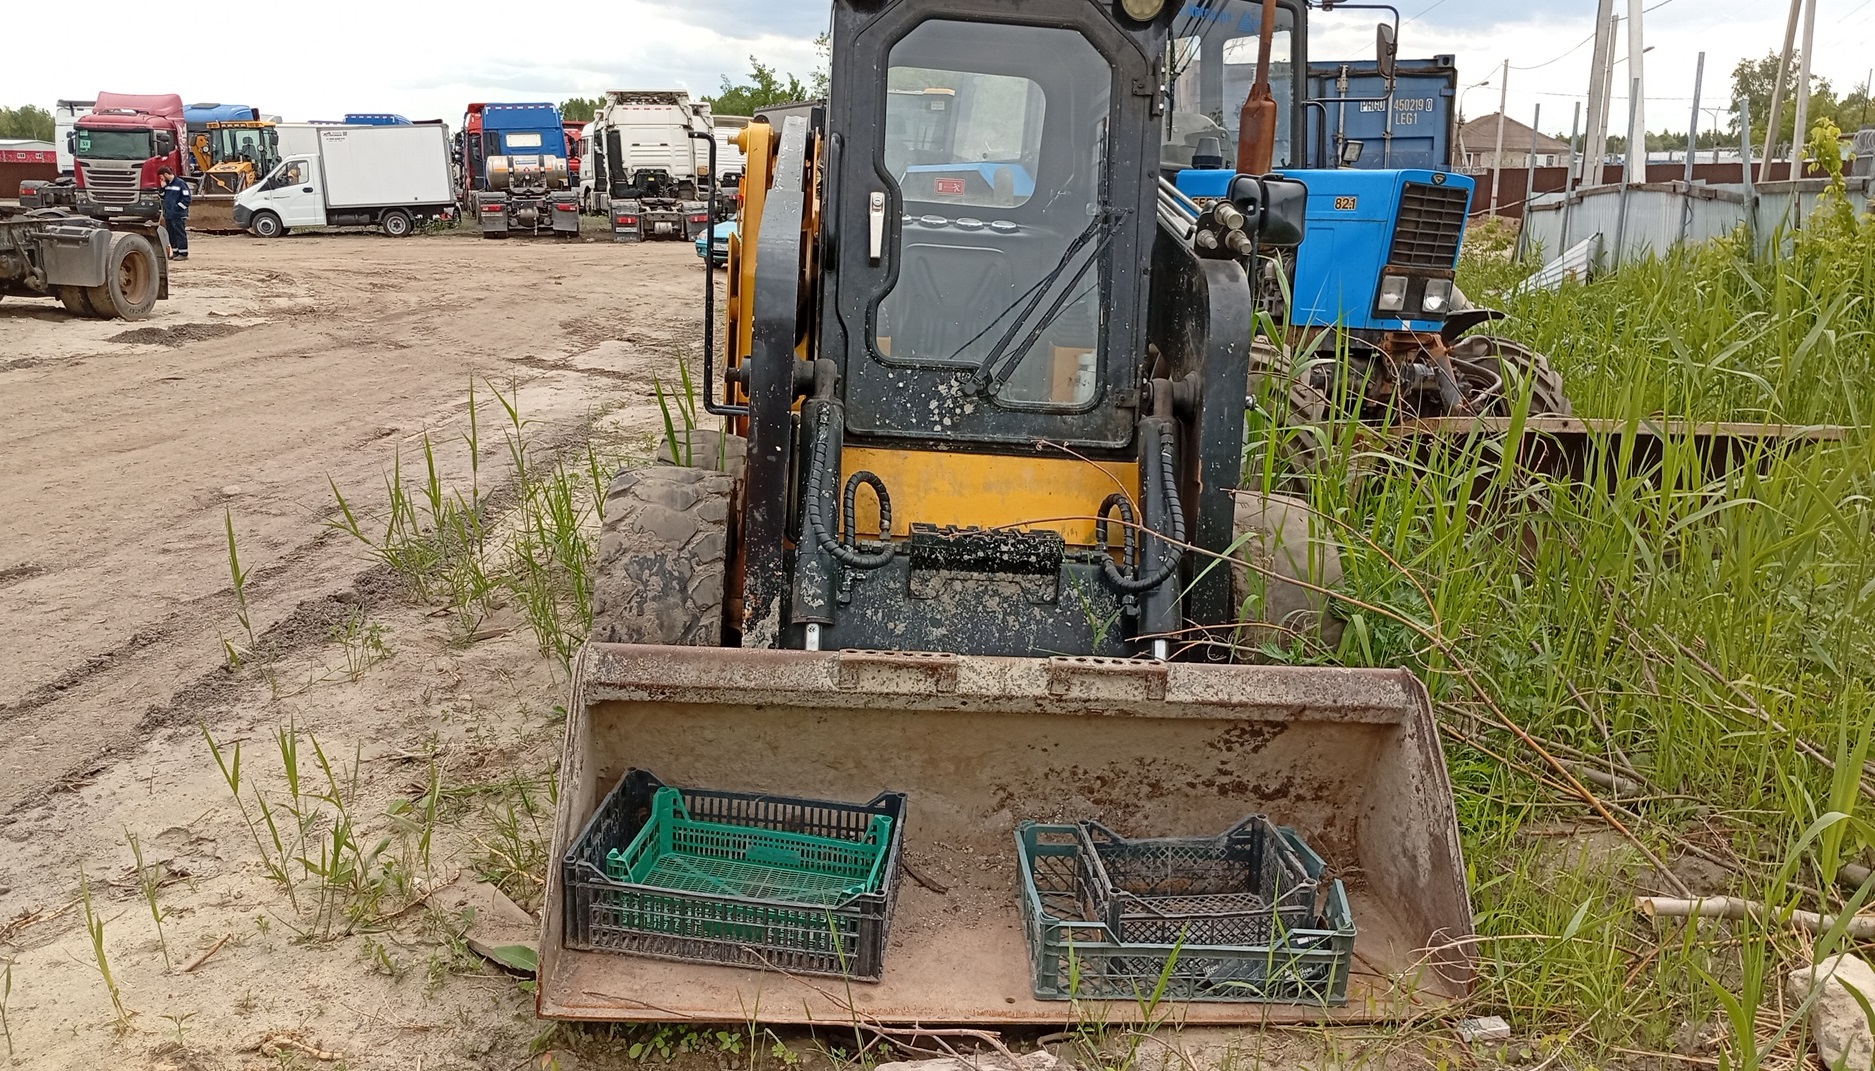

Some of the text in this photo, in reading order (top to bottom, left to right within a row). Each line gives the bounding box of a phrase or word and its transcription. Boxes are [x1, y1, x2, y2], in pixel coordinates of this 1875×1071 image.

[1394, 99, 1423, 111] 450219
[1395, 113, 1417, 125] LEG1
[1335, 197, 1356, 210] 82.1
